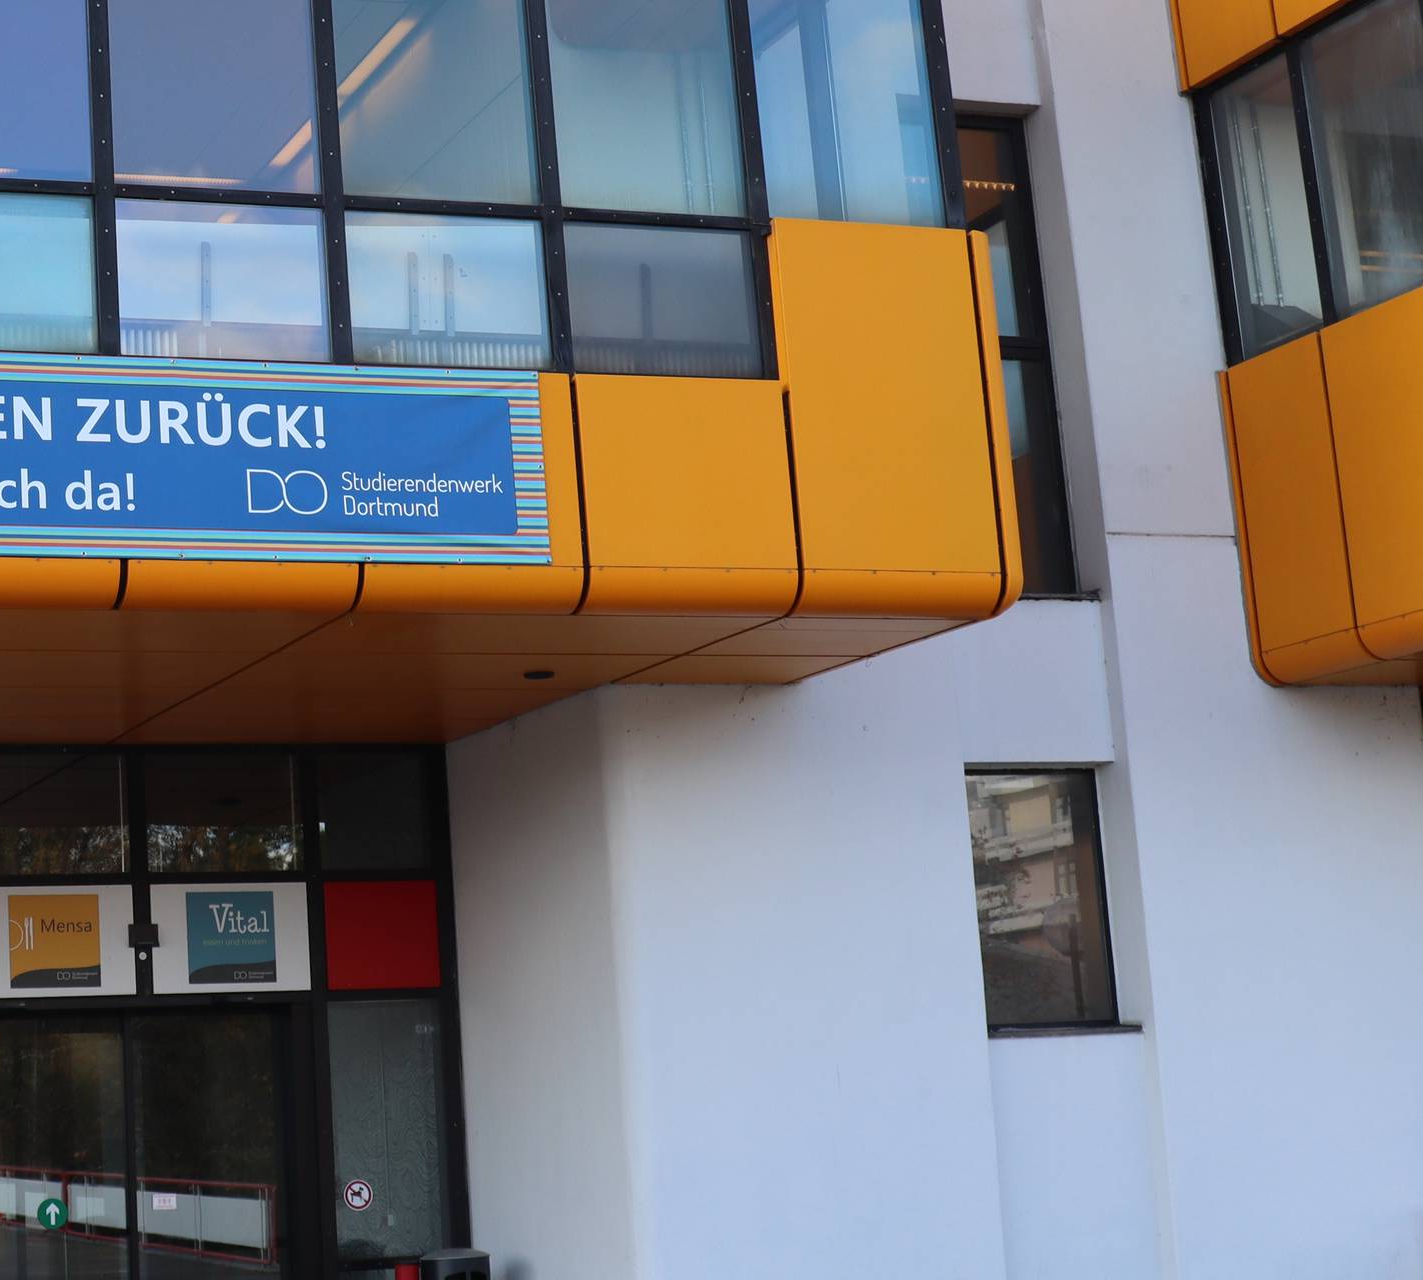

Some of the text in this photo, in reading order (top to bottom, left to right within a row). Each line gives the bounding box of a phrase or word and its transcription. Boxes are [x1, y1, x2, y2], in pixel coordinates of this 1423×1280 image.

[76, 392, 327, 449] ZURÜCK!
[64, 470, 137, 511] da!
[246, 468, 328, 515] DO
[341, 471, 503, 494] Studierendenwerk
[343, 495, 439, 517] Dortmund
[40, 918, 93, 934] Mensa
[209, 903, 270, 934] Vital
